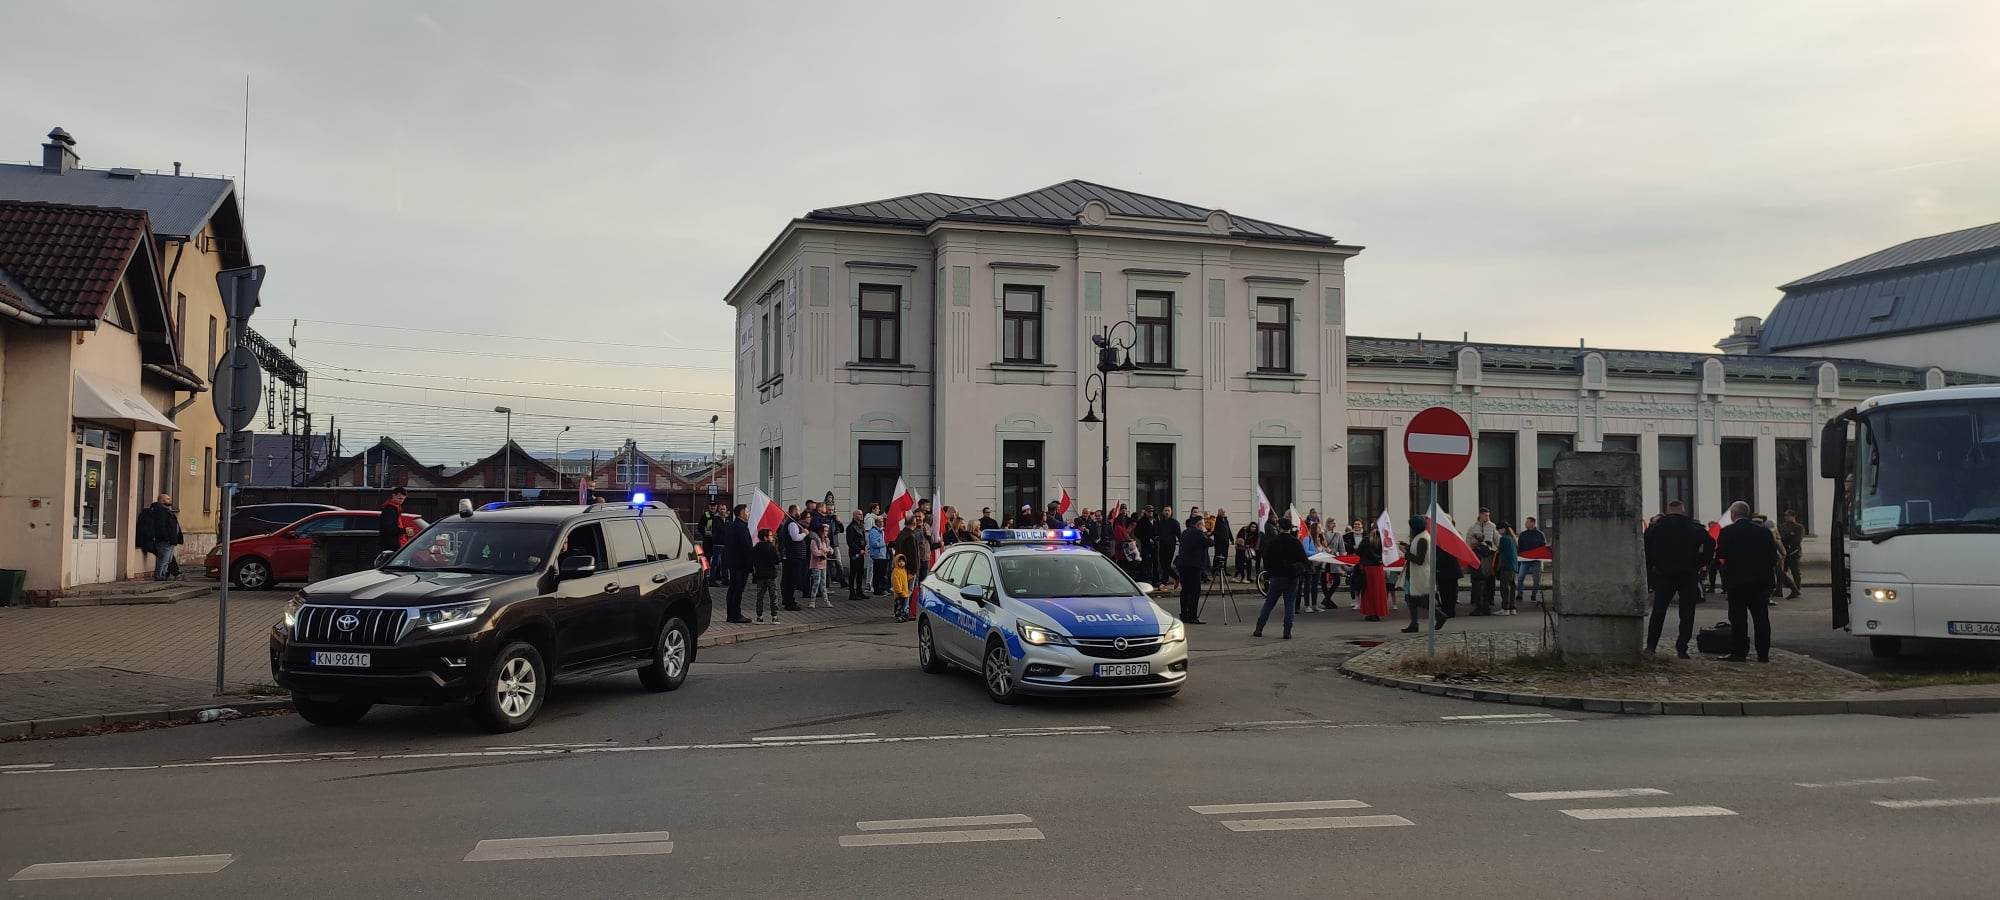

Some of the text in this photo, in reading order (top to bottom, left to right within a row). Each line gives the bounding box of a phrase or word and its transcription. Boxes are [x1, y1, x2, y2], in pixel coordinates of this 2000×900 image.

[1016, 530, 1048, 539] POLICJA
[956, 614, 977, 631] POLICJA
[1074, 613, 1145, 623] POLICJA
[1955, 623, 1973, 633] LUB
[317, 652, 368, 666] KN 9861C
[1100, 664, 1148, 676] HPG B870
